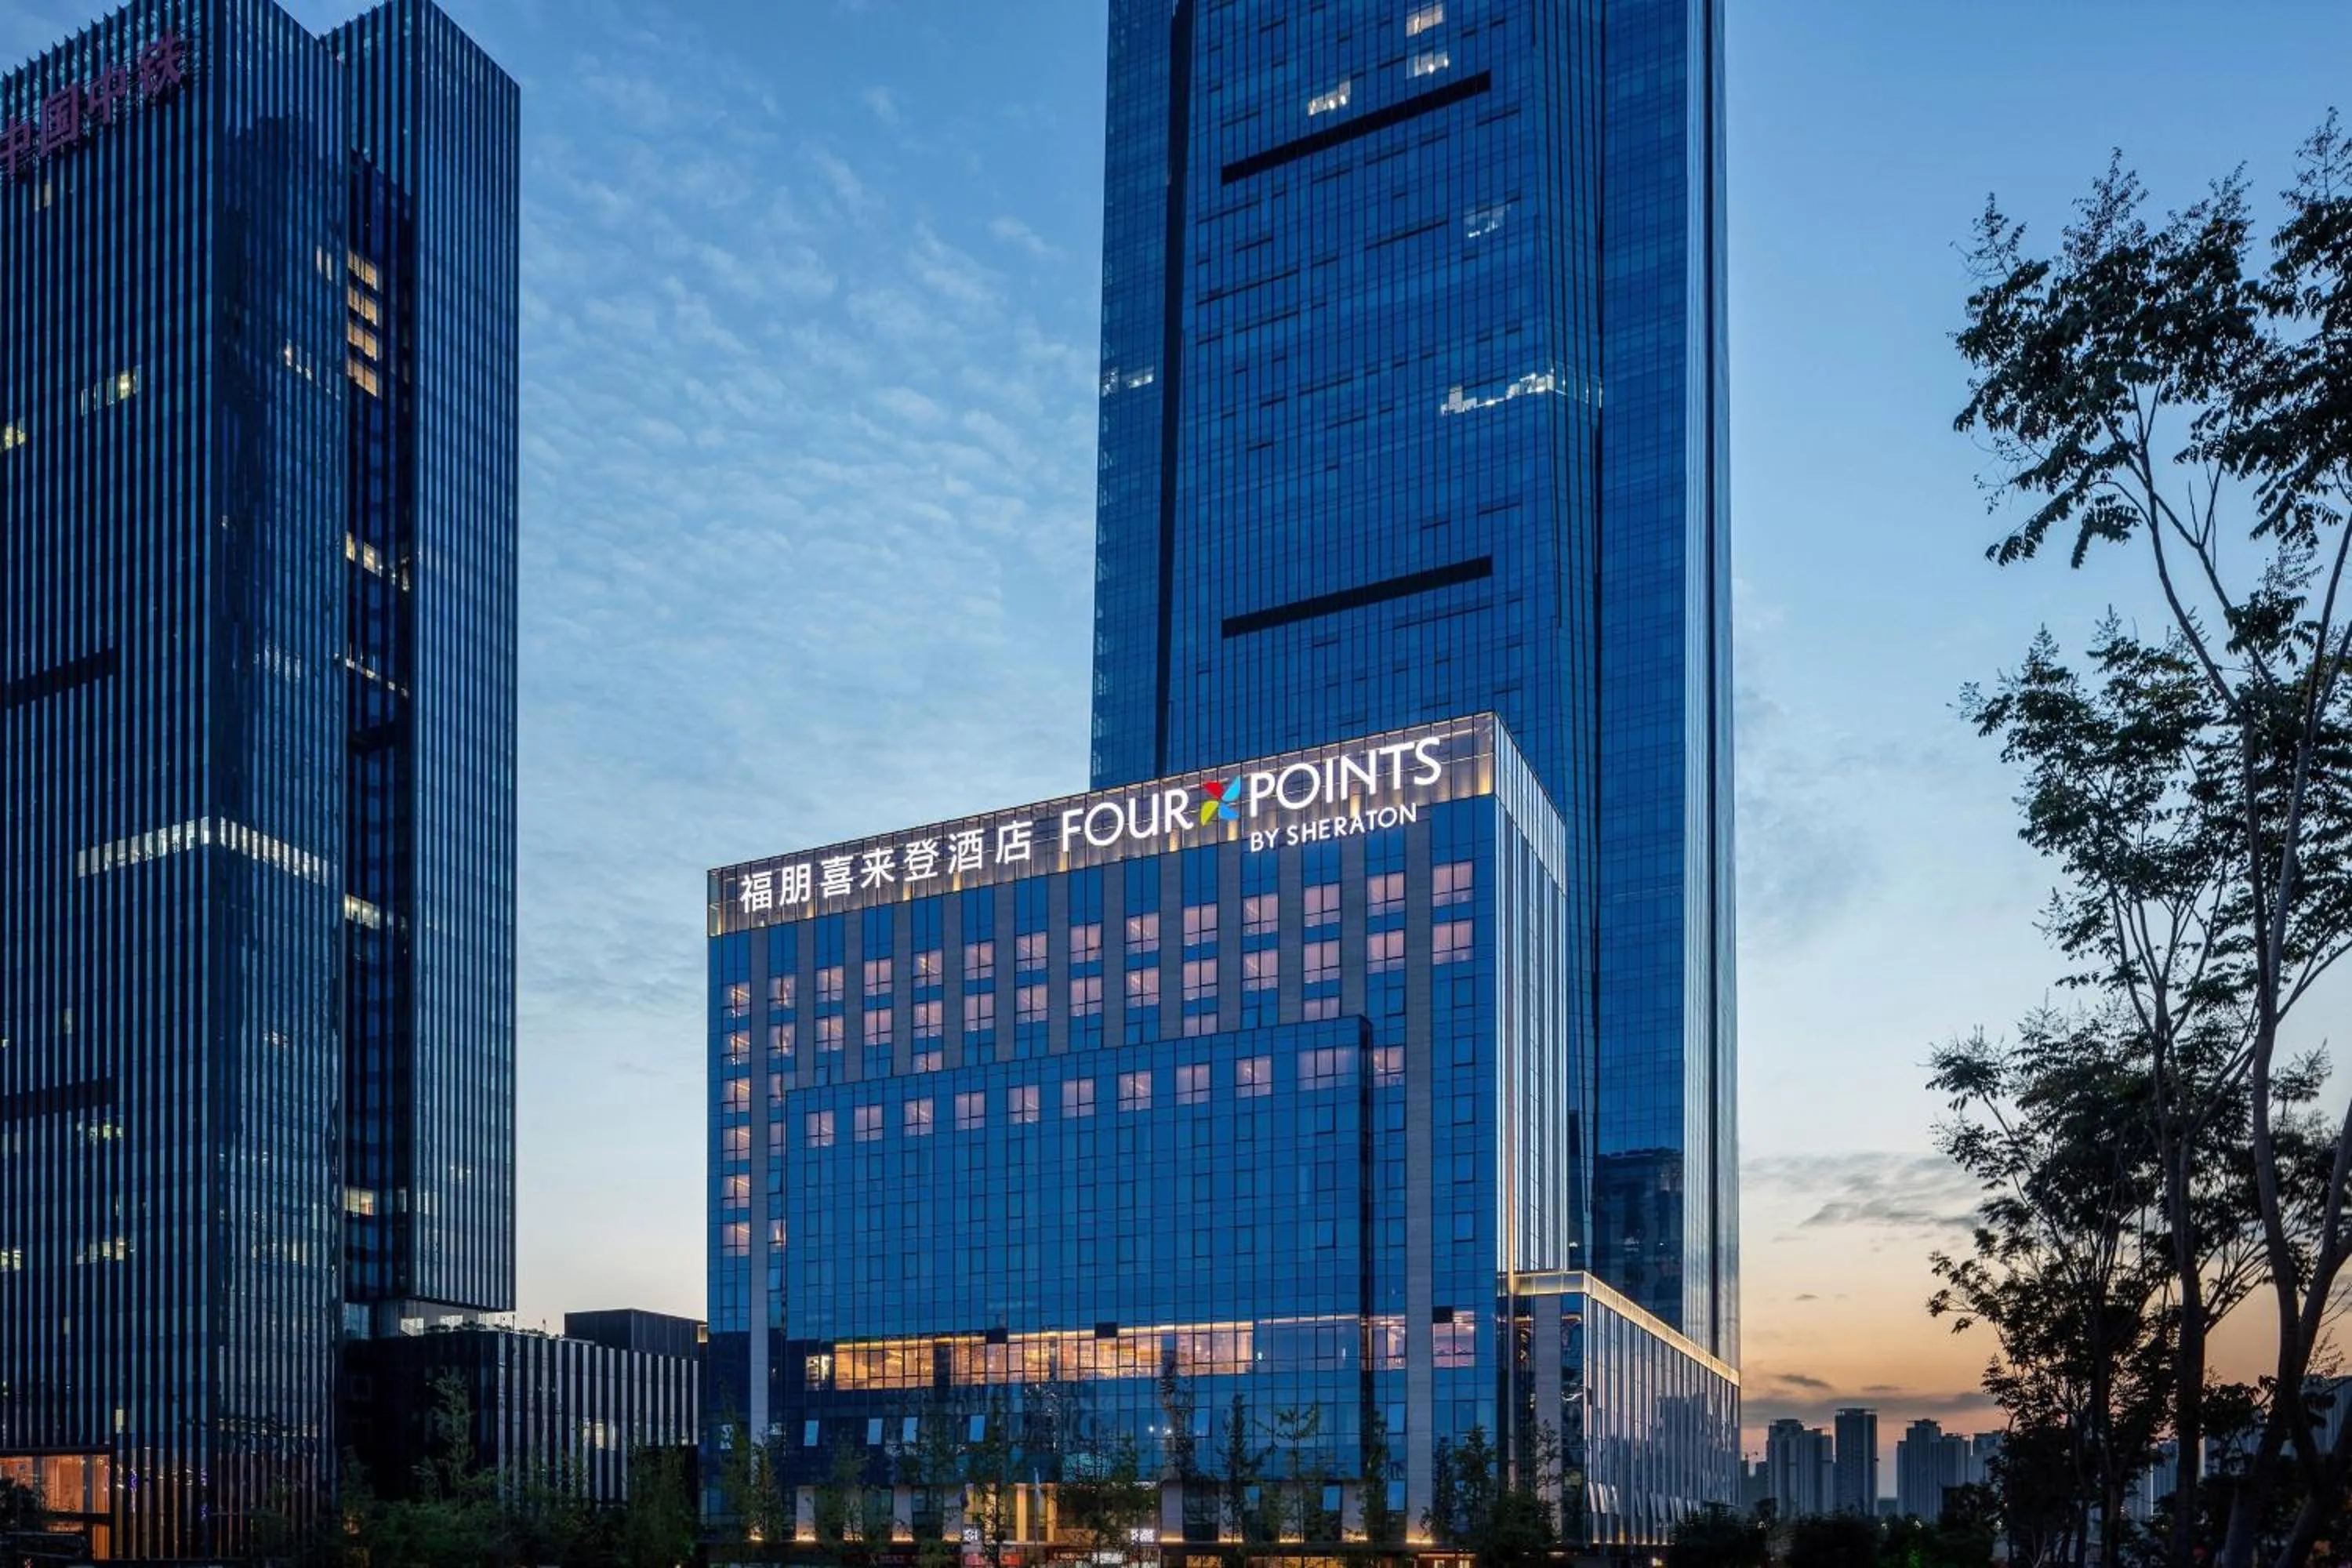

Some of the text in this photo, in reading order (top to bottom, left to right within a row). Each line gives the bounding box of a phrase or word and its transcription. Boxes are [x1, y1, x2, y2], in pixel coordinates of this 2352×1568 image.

[0, 26, 183, 177] 中国中铁
[1062, 735, 1443, 853] FOUR POINTS
[1250, 801, 1417, 853] BY SHERATON
[739, 819, 1033, 914] 福朋喜来登酒店
